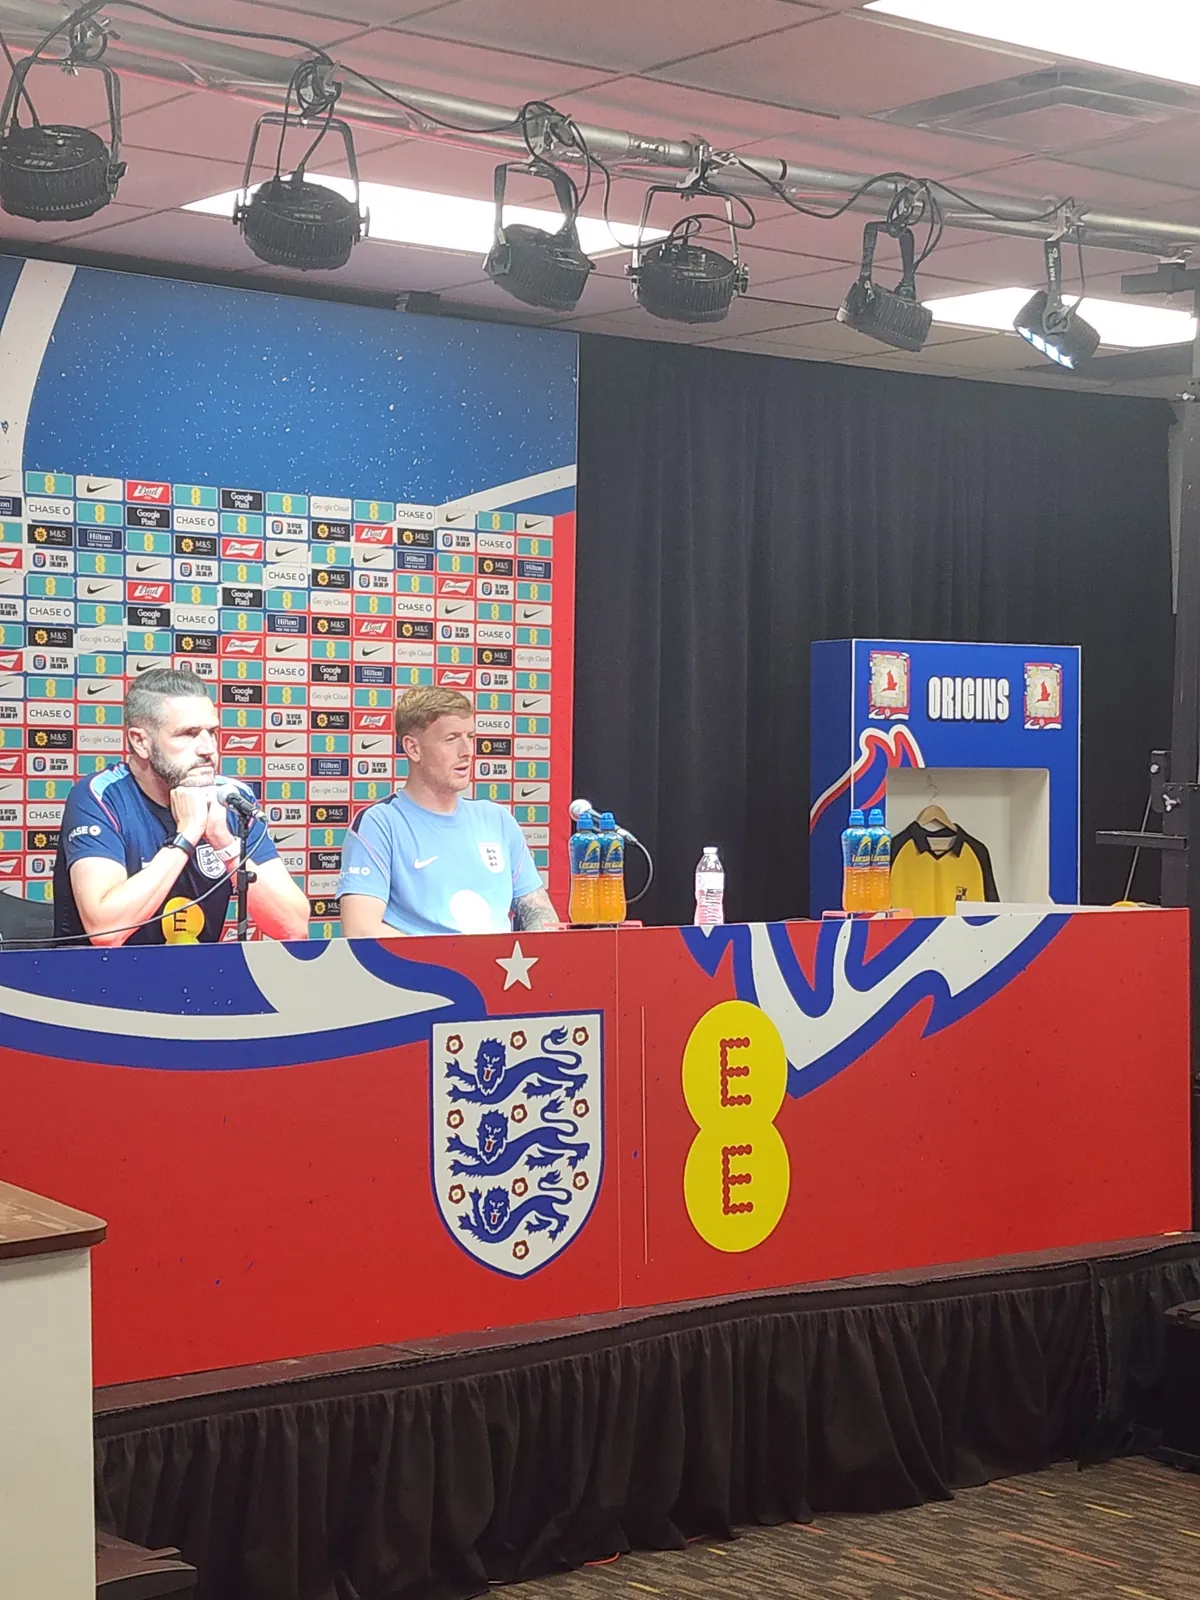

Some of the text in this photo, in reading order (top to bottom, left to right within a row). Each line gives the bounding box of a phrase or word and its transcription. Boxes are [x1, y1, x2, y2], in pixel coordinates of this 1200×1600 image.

[231, 492, 254, 503] Google
[29, 504, 61, 514] CHASE
[137, 509, 161, 520] Google
[399, 510, 425, 518] CHASE
[177, 516, 206, 525] CHASE
[50, 530, 67, 538] M&S
[331, 526, 346, 534] M&S
[196, 540, 212, 548] M&S
[479, 539, 504, 548] CHASE
[268, 571, 297, 580] CHASE
[331, 574, 346, 582] M&S
[230, 590, 254, 600] Google
[398, 603, 424, 611] CHASE
[29, 608, 61, 616] CHASE
[137, 609, 161, 620] Google
[177, 615, 206, 624] CHASE
[50, 632, 67, 640] M&S
[268, 668, 296, 676] CHASE
[320, 666, 341, 676] Google
[230, 687, 253, 697] Google
[928, 676, 1010, 720] ORIGINS
[30, 710, 61, 718] CHASE
[318, 854, 340, 863] Google
